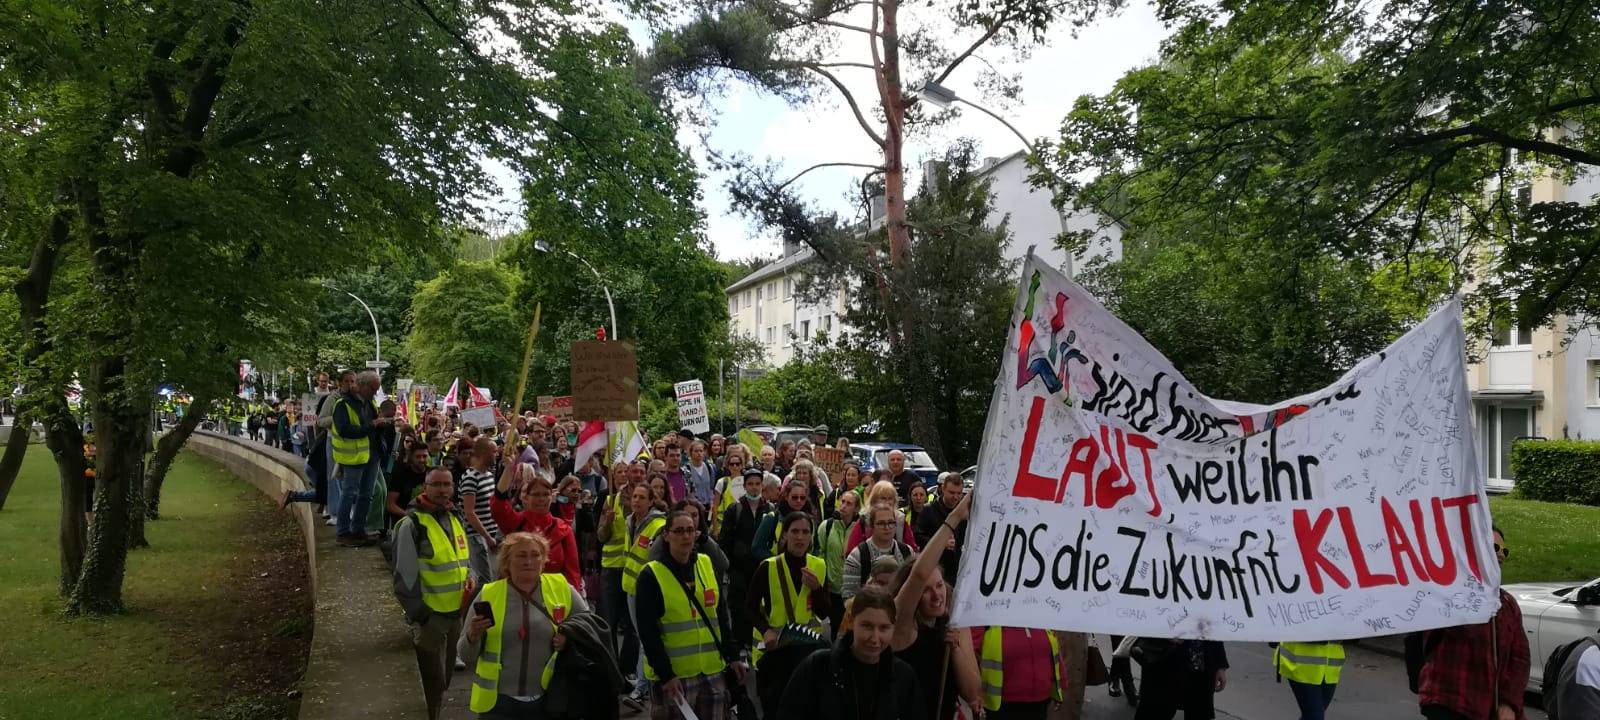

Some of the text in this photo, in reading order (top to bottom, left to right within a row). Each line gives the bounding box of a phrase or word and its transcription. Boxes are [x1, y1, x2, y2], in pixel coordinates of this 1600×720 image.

[677, 397, 701, 408] COME IN
[1081, 353, 1168, 432] sind
[1156, 381, 1242, 444] hier
[1167, 438, 1261, 505] weil
[1261, 427, 1320, 503] ihr
[1052, 519, 1112, 593] die
[1292, 495, 1483, 595] KLAUT
[1267, 594, 1344, 628] MICHELLE
